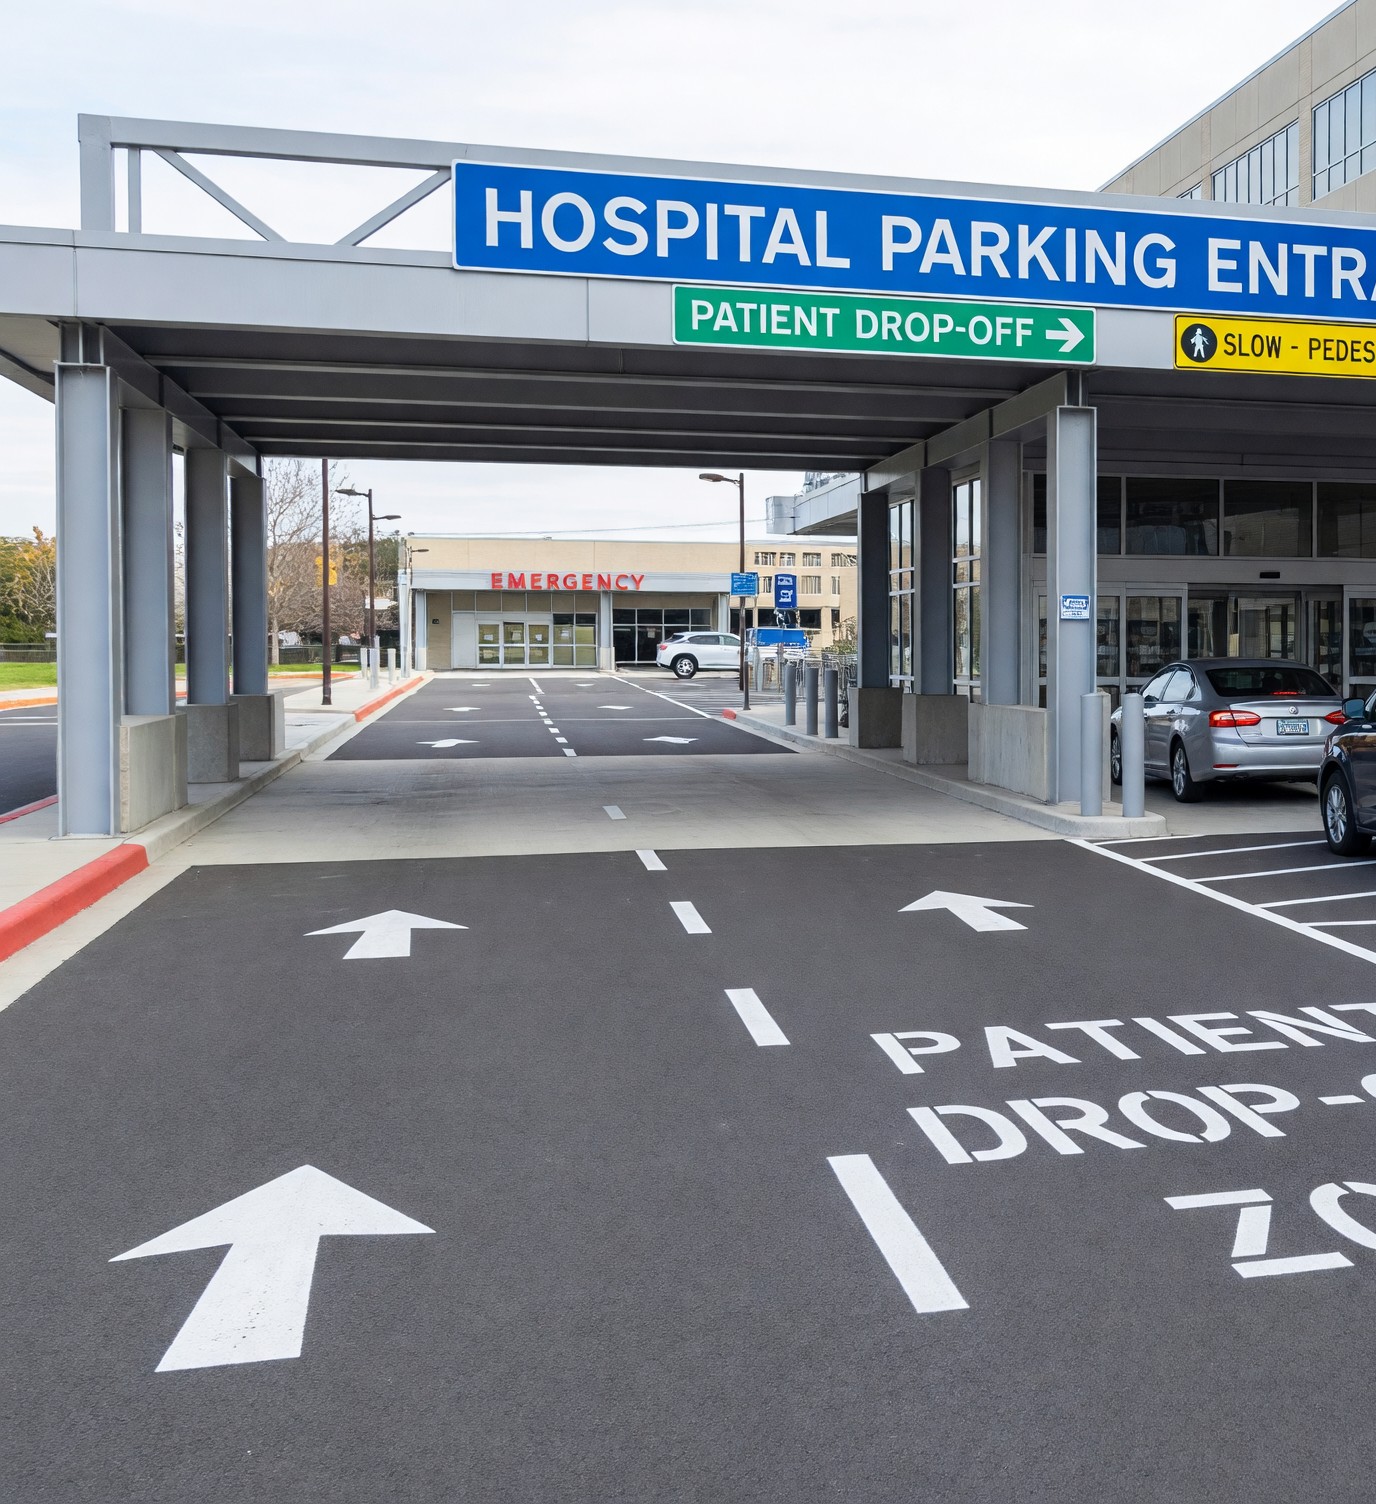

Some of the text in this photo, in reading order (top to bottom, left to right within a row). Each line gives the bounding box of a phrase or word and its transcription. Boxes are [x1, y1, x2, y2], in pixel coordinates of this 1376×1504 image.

[483, 187, 851, 270] HOSPITAL
[881, 215, 1178, 290] PARKING
[690, 299, 1035, 348] PATIENT DROP-OFF
[1223, 332, 1283, 360] SLOW
[490, 572, 646, 592] EMERGENCY
